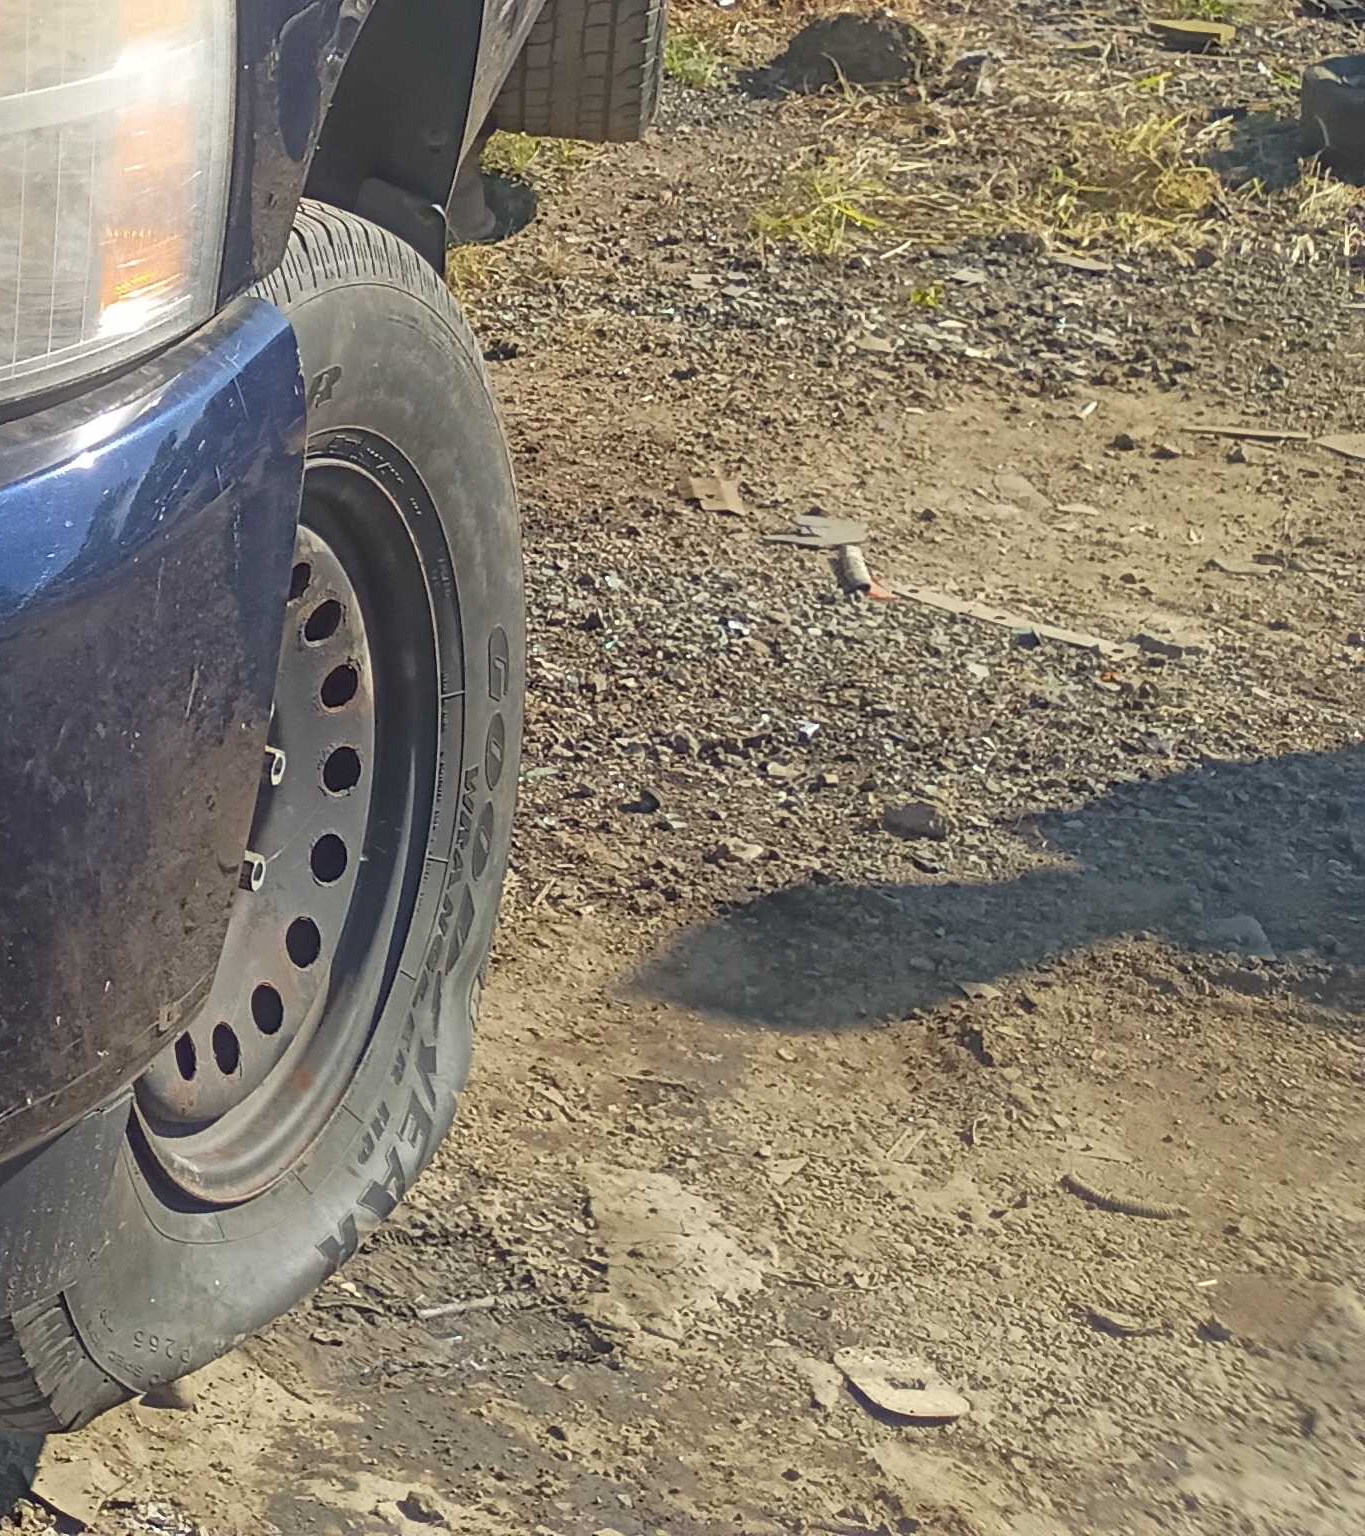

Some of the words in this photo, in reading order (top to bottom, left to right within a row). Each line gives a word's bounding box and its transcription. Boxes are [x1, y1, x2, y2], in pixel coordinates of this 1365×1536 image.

[315, 624, 511, 1272] GOODYEAR
[390, 765, 479, 1086] WRANGLER
[357, 1100, 390, 1165] HP
